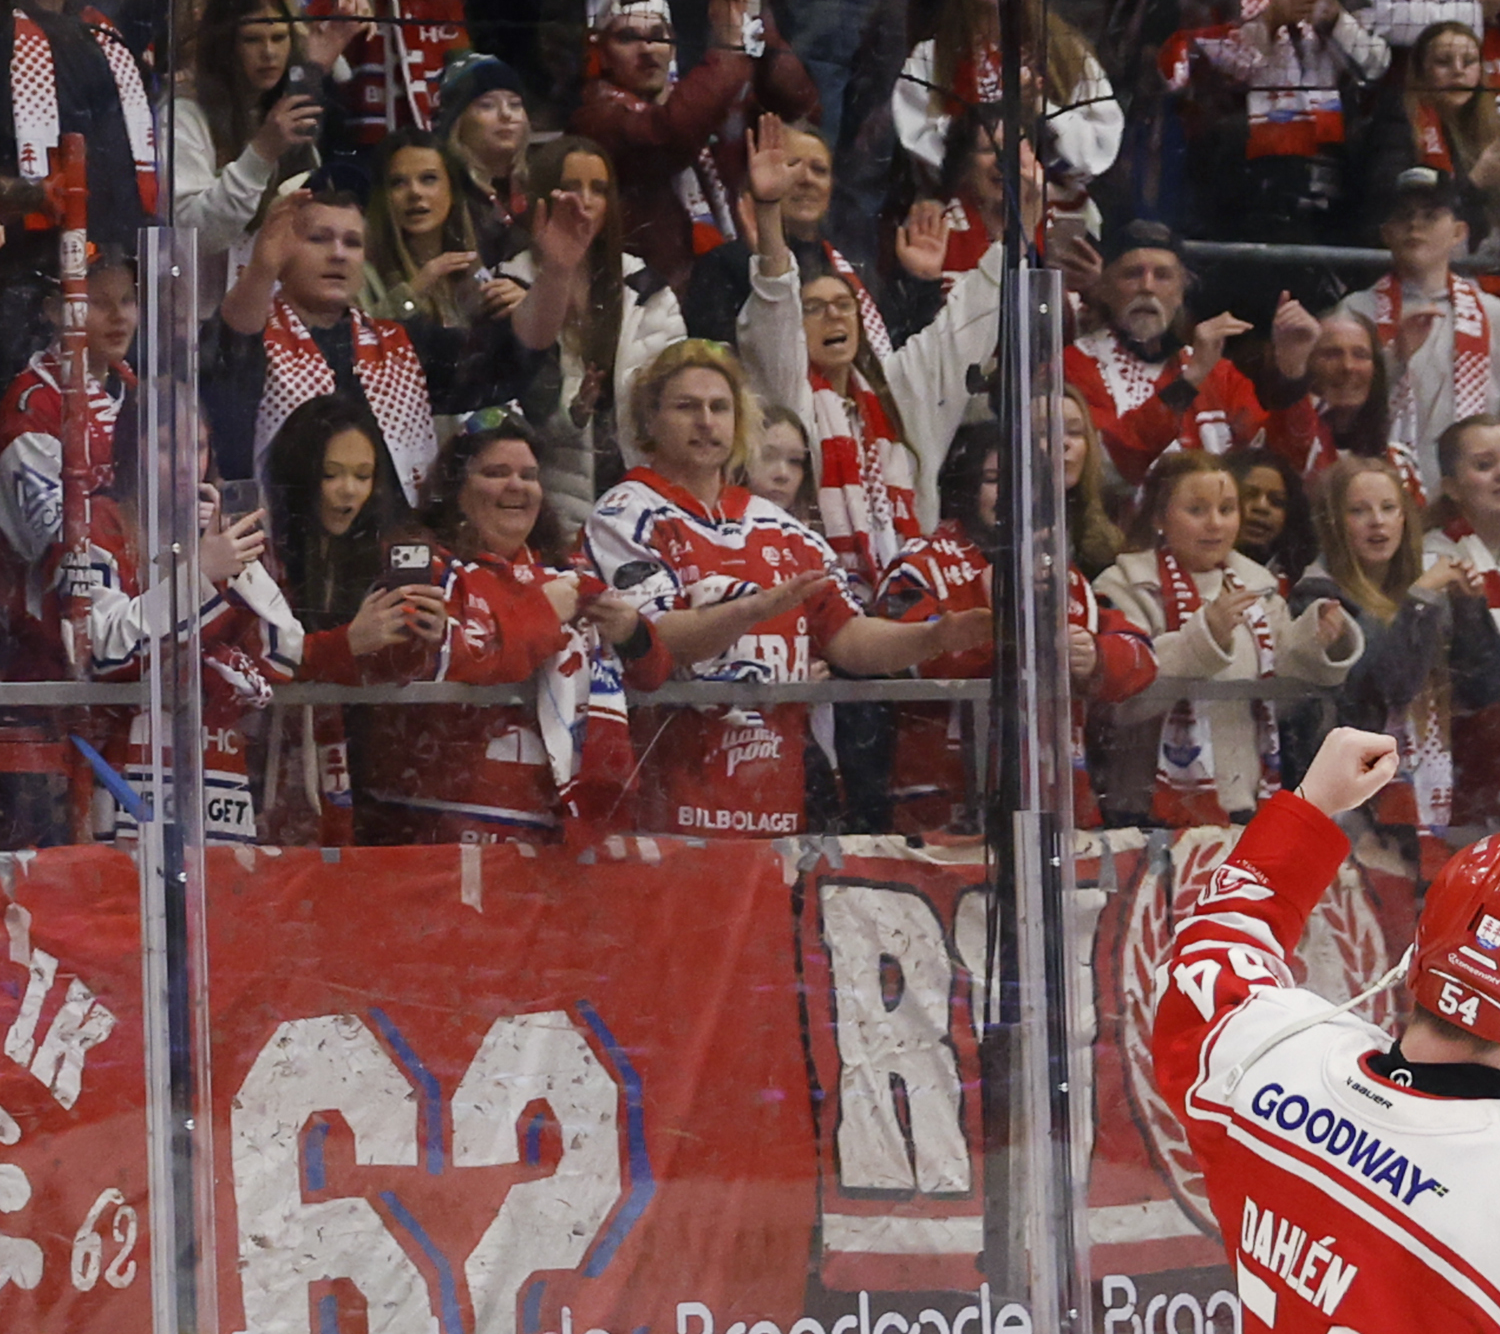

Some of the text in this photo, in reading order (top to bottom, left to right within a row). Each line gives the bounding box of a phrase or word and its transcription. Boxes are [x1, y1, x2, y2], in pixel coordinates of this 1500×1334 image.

[677, 805, 799, 833] BILBOLAGET
[1437, 980, 1481, 1027] 54
[1250, 1082, 1434, 1206] GOODWAY
[68, 1186, 138, 1292] 62
[1242, 1194, 1358, 1319] DAHLÉN
